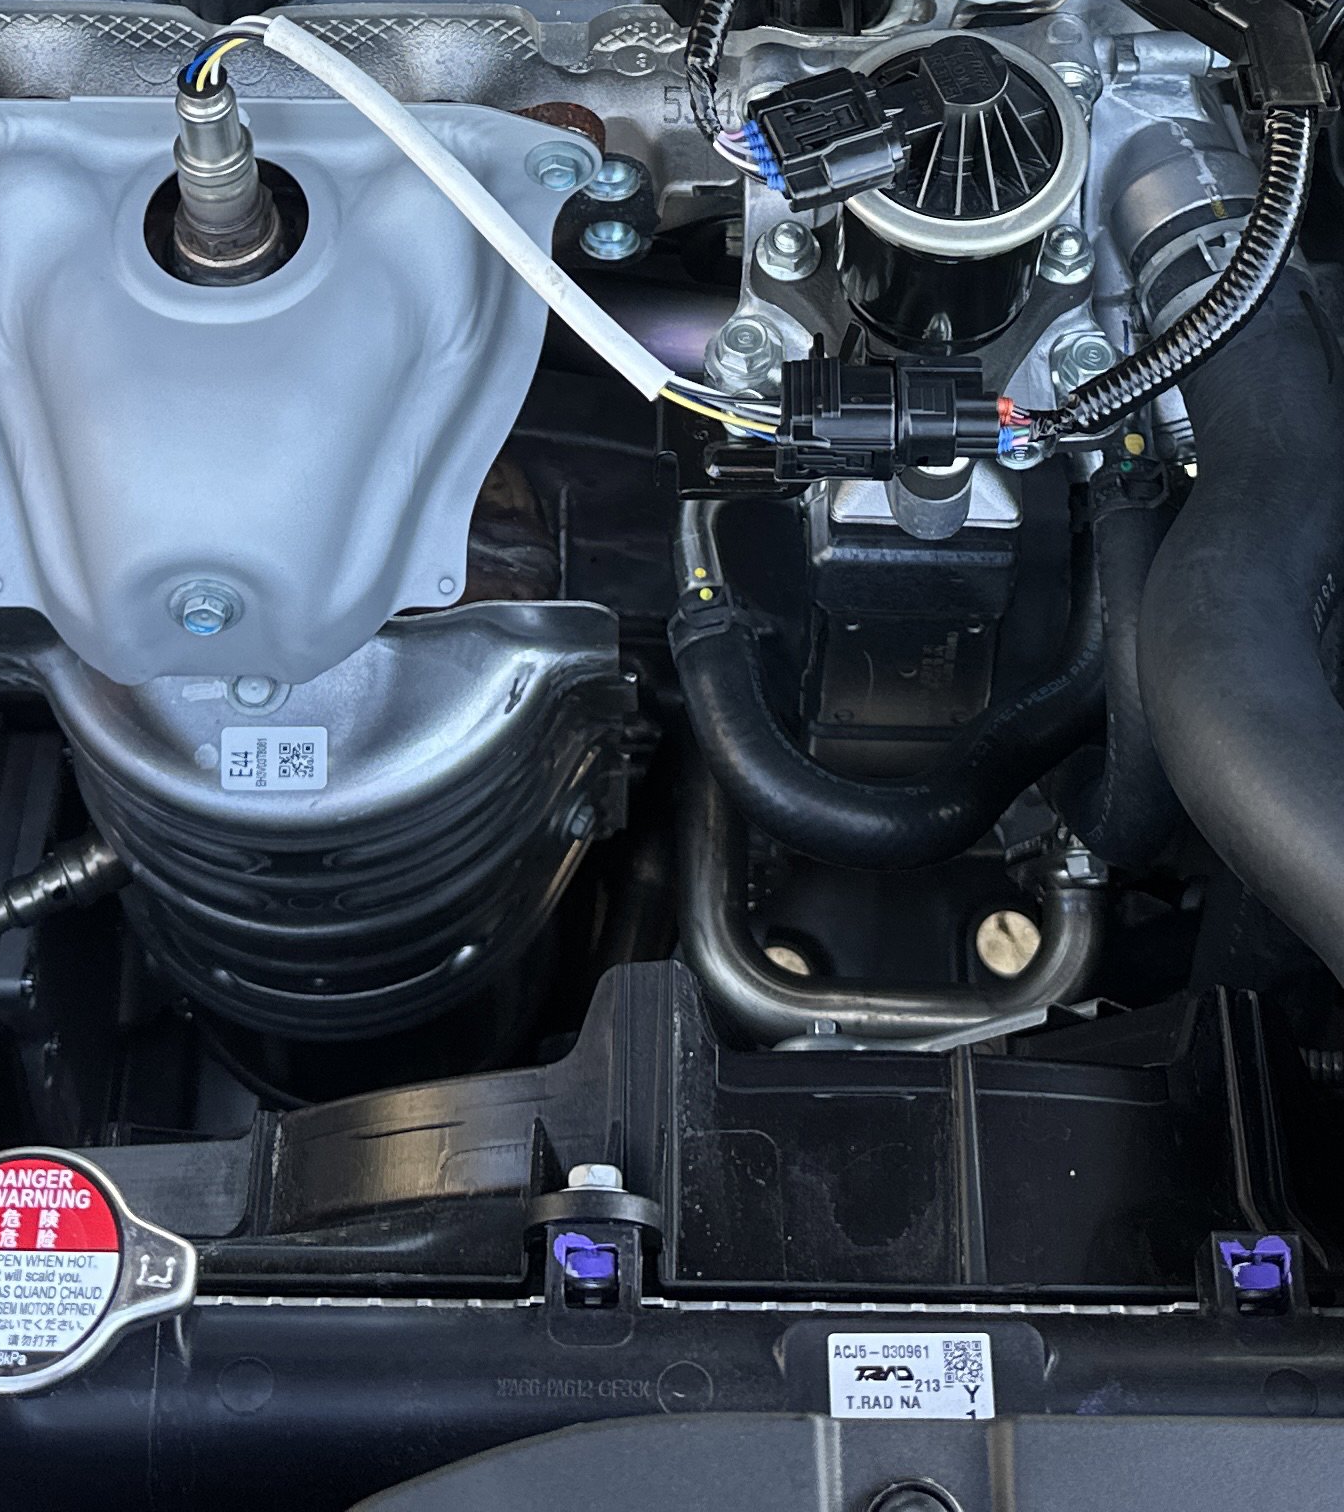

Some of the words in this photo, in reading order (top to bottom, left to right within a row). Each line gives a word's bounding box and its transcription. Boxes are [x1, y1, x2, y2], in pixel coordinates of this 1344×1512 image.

[229, 750, 254, 777] E44
[25, 1255, 64, 1268] WHEN
[67, 1255, 99, 1269] HOT.
[5, 1269, 22, 1282] will
[24, 1269, 56, 1283] scald
[57, 1273, 83, 1286] you.
[13, 1286, 57, 1299] QUAND
[59, 1286, 104, 1300] CHAUD.
[19, 1302, 55, 1316] MOTOR
[963, 1384, 981, 1404] Y
[846, 1395, 894, 1410] T.RAD
[900, 1395, 922, 1410] NA
